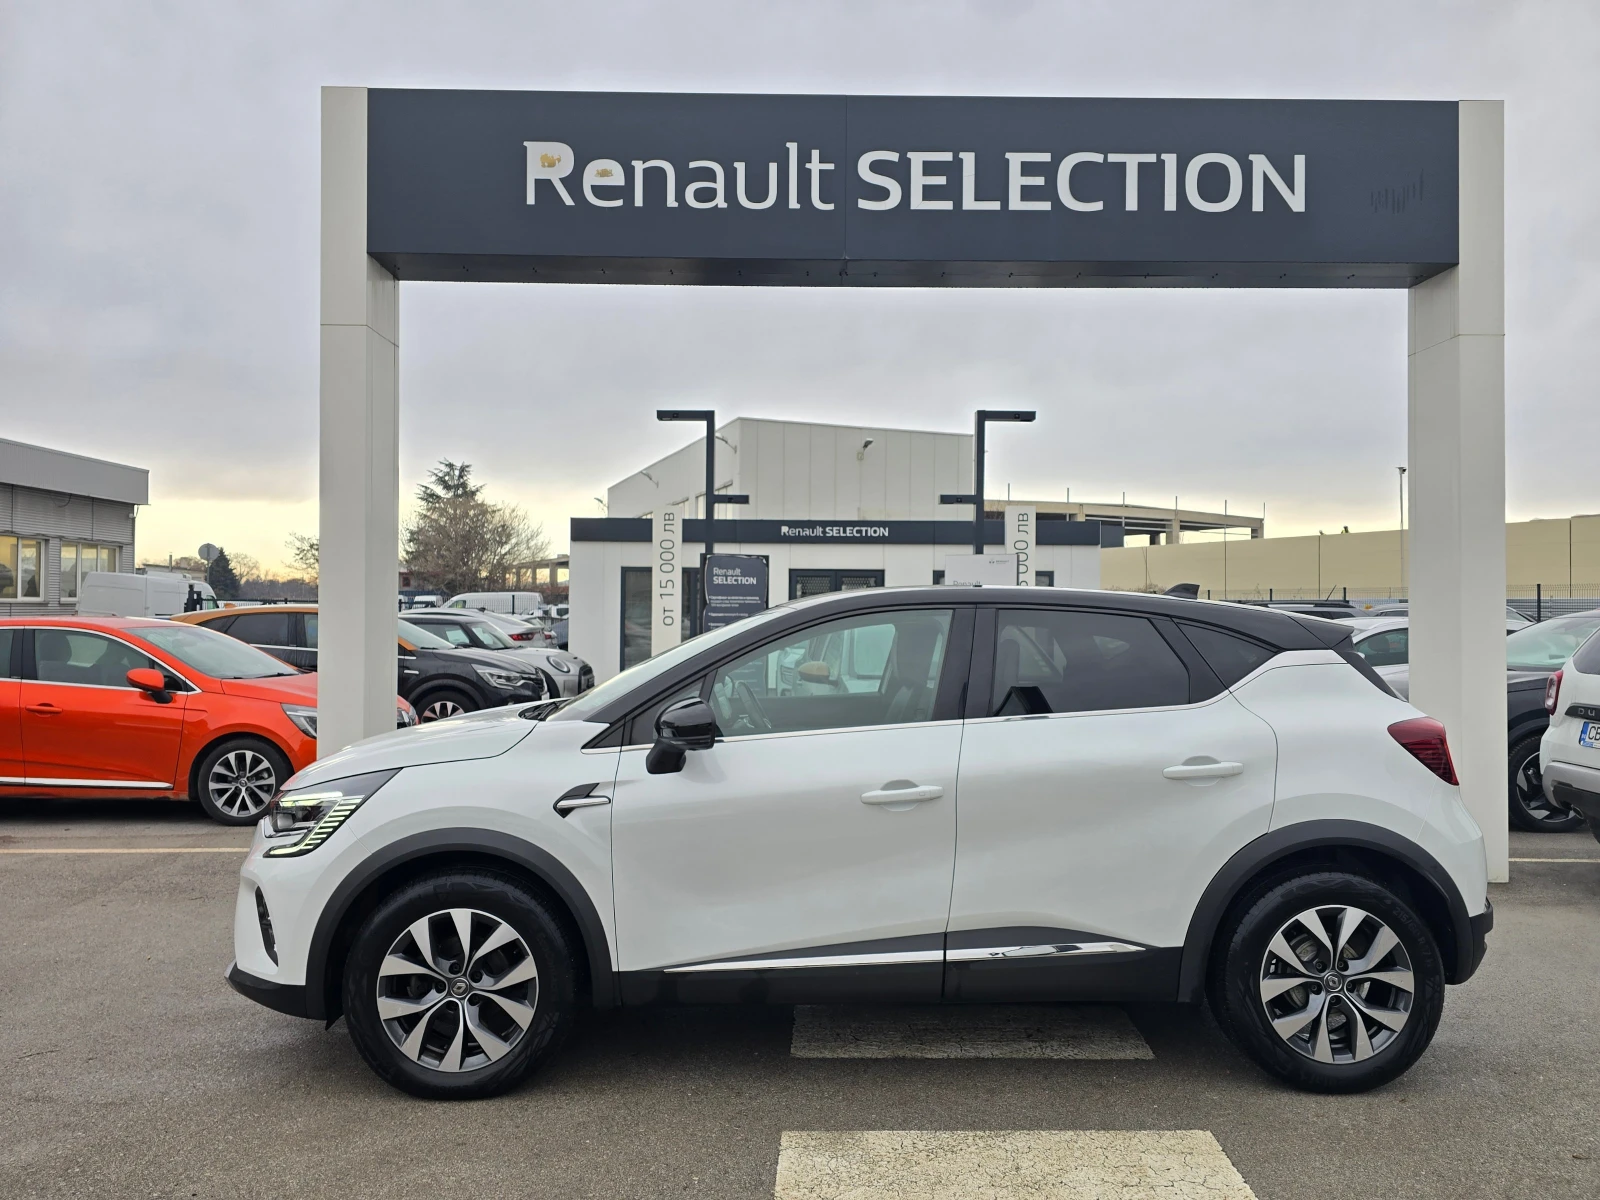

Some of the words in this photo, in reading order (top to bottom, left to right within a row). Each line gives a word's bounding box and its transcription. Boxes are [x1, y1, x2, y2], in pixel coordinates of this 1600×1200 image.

[523, 141, 835, 211] Renault
[857, 150, 1307, 213] SELECTION
[781, 525, 824, 536] Renault
[825, 526, 889, 537] SELECTION
[660, 539, 675, 574] 000
[713, 567, 741, 576] Renault
[713, 576, 757, 585] SELECTION
[660, 579, 675, 600] 15
